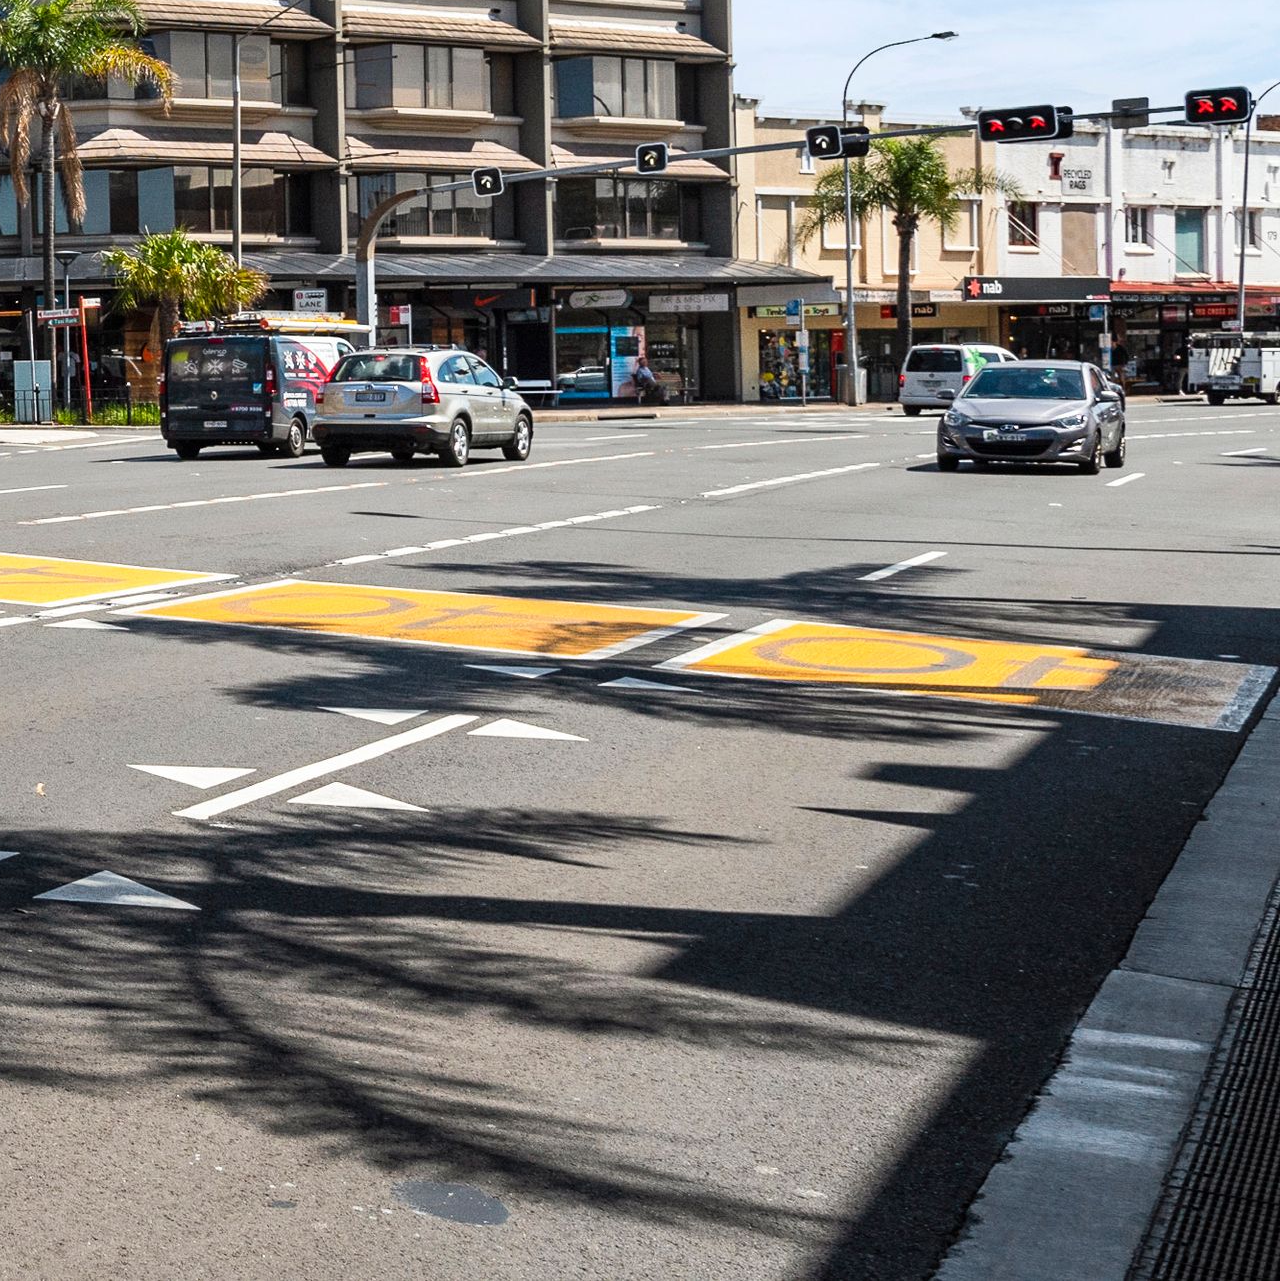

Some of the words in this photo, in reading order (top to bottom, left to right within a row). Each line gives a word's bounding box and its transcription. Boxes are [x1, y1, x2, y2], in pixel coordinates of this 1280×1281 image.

[1063, 169, 1092, 180] RECYCLED
[1069, 180, 1087, 190] RAGS
[982, 279, 1003, 294] nab
[914, 305, 934, 314] nab
[1049, 305, 1069, 313] nab
